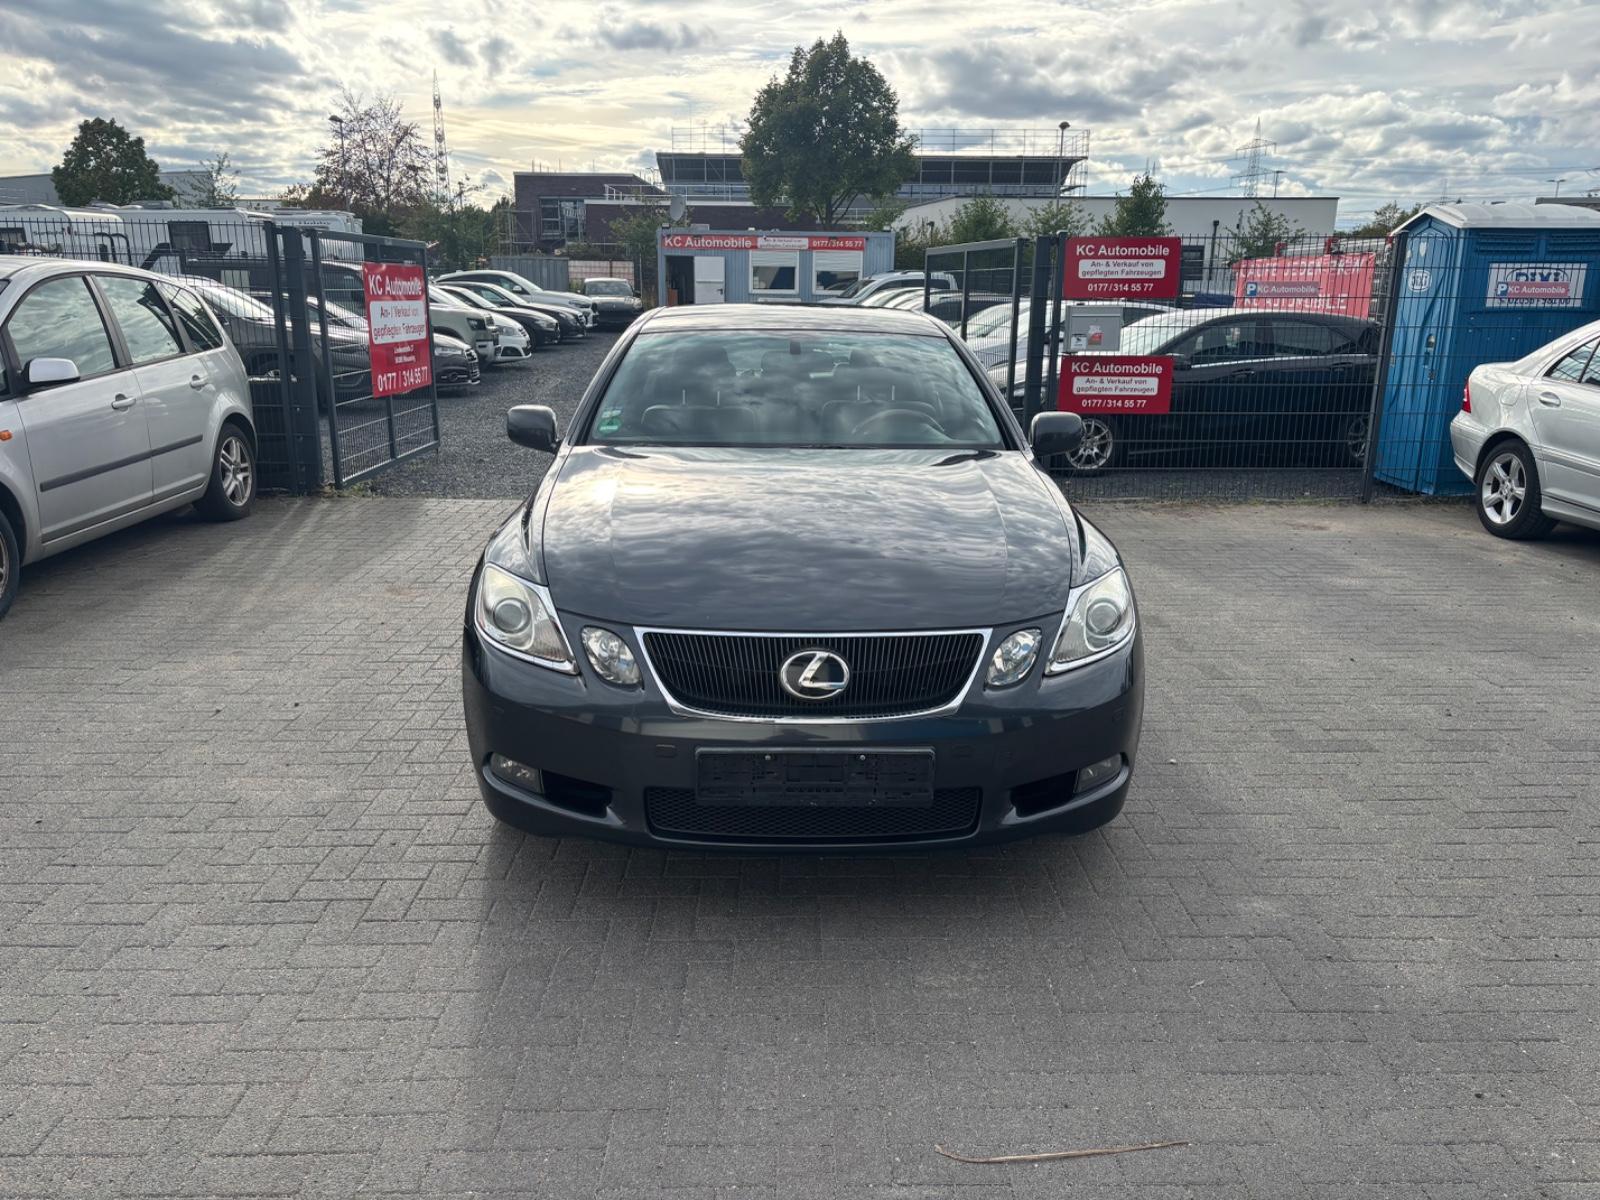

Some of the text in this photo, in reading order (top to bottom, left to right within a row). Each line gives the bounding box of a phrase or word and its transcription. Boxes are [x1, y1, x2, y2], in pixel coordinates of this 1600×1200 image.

[664, 236, 681, 246] KC
[685, 236, 752, 248] Automobile
[1076, 245, 1169, 255] KC Automobile
[368, 274, 422, 296] KC Automobile
[1131, 284, 1141, 292] 55
[1144, 284, 1153, 292] 77
[1271, 285, 1318, 293] Automobile
[1071, 362, 1162, 374] KC Automobile
[377, 372, 396, 392] 0177
